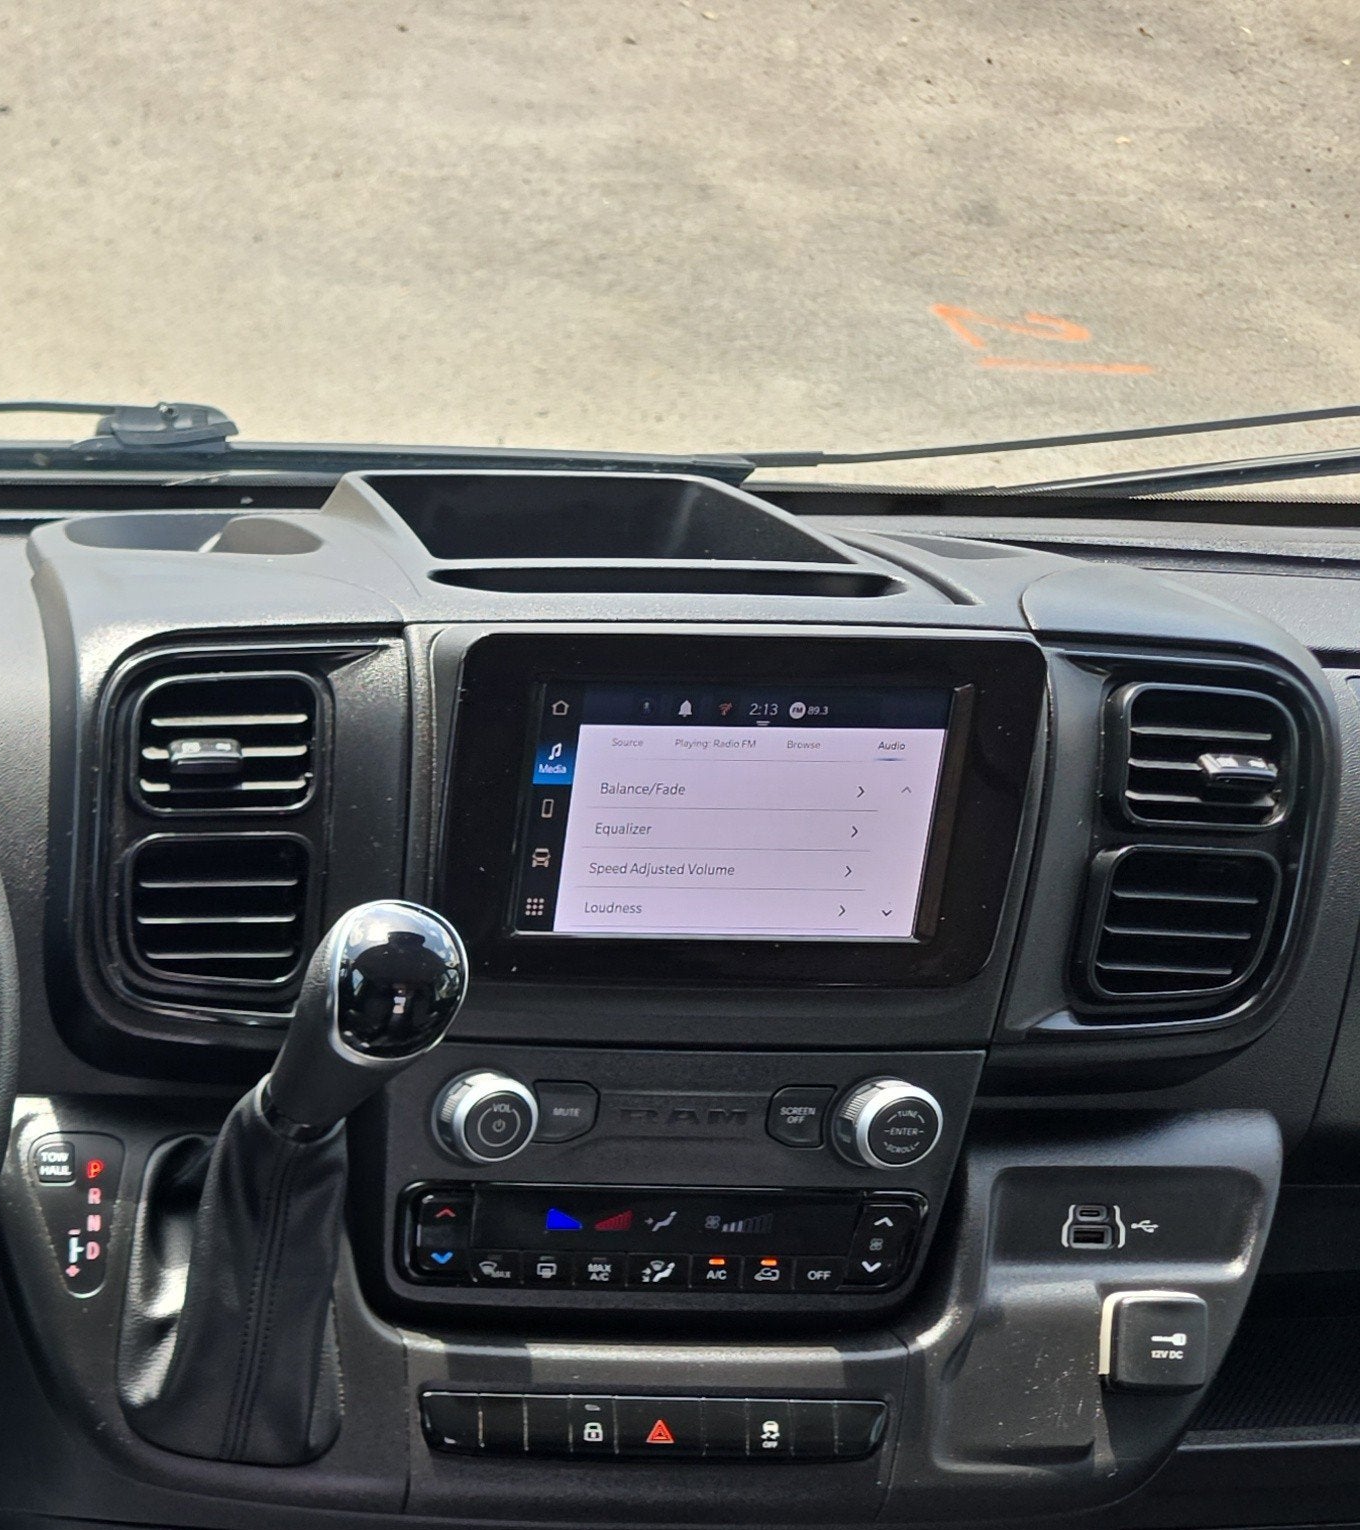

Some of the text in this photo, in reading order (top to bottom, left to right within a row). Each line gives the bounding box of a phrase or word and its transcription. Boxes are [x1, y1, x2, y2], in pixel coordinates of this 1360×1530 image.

[749, 703, 779, 716] 2:13
[807, 706, 829, 716] 89.3
[611, 738, 644, 747] Source
[713, 739, 739, 749] Radio
[741, 740, 757, 749] FM
[786, 740, 821, 749] Browse
[878, 741, 906, 751] Audio
[538, 764, 567, 775] Media
[600, 782, 686, 796] Balance/Fade
[595, 822, 652, 835] Equalizer
[589, 862, 735, 877] Speed Adjusted Volume
[584, 902, 643, 914] Loudness
[492, 1103, 511, 1113] VOL
[552, 1107, 581, 1117] MUTE
[780, 1106, 817, 1116] SCREEN
[619, 1107, 748, 1126] RAM
[787, 1115, 805, 1124] OFF
[895, 1110, 918, 1119] TUNE
[889, 1127, 918, 1136] ENTER
[40, 1152, 70, 1163] TOW
[87, 1159, 105, 1179] P
[87, 1187, 102, 1205] R
[85, 1241, 101, 1260] D
[589, 1272, 610, 1282] A/C
[706, 1269, 727, 1280] A/C
[806, 1270, 831, 1281] OFF
[1169, 1350, 1184, 1360] DC
